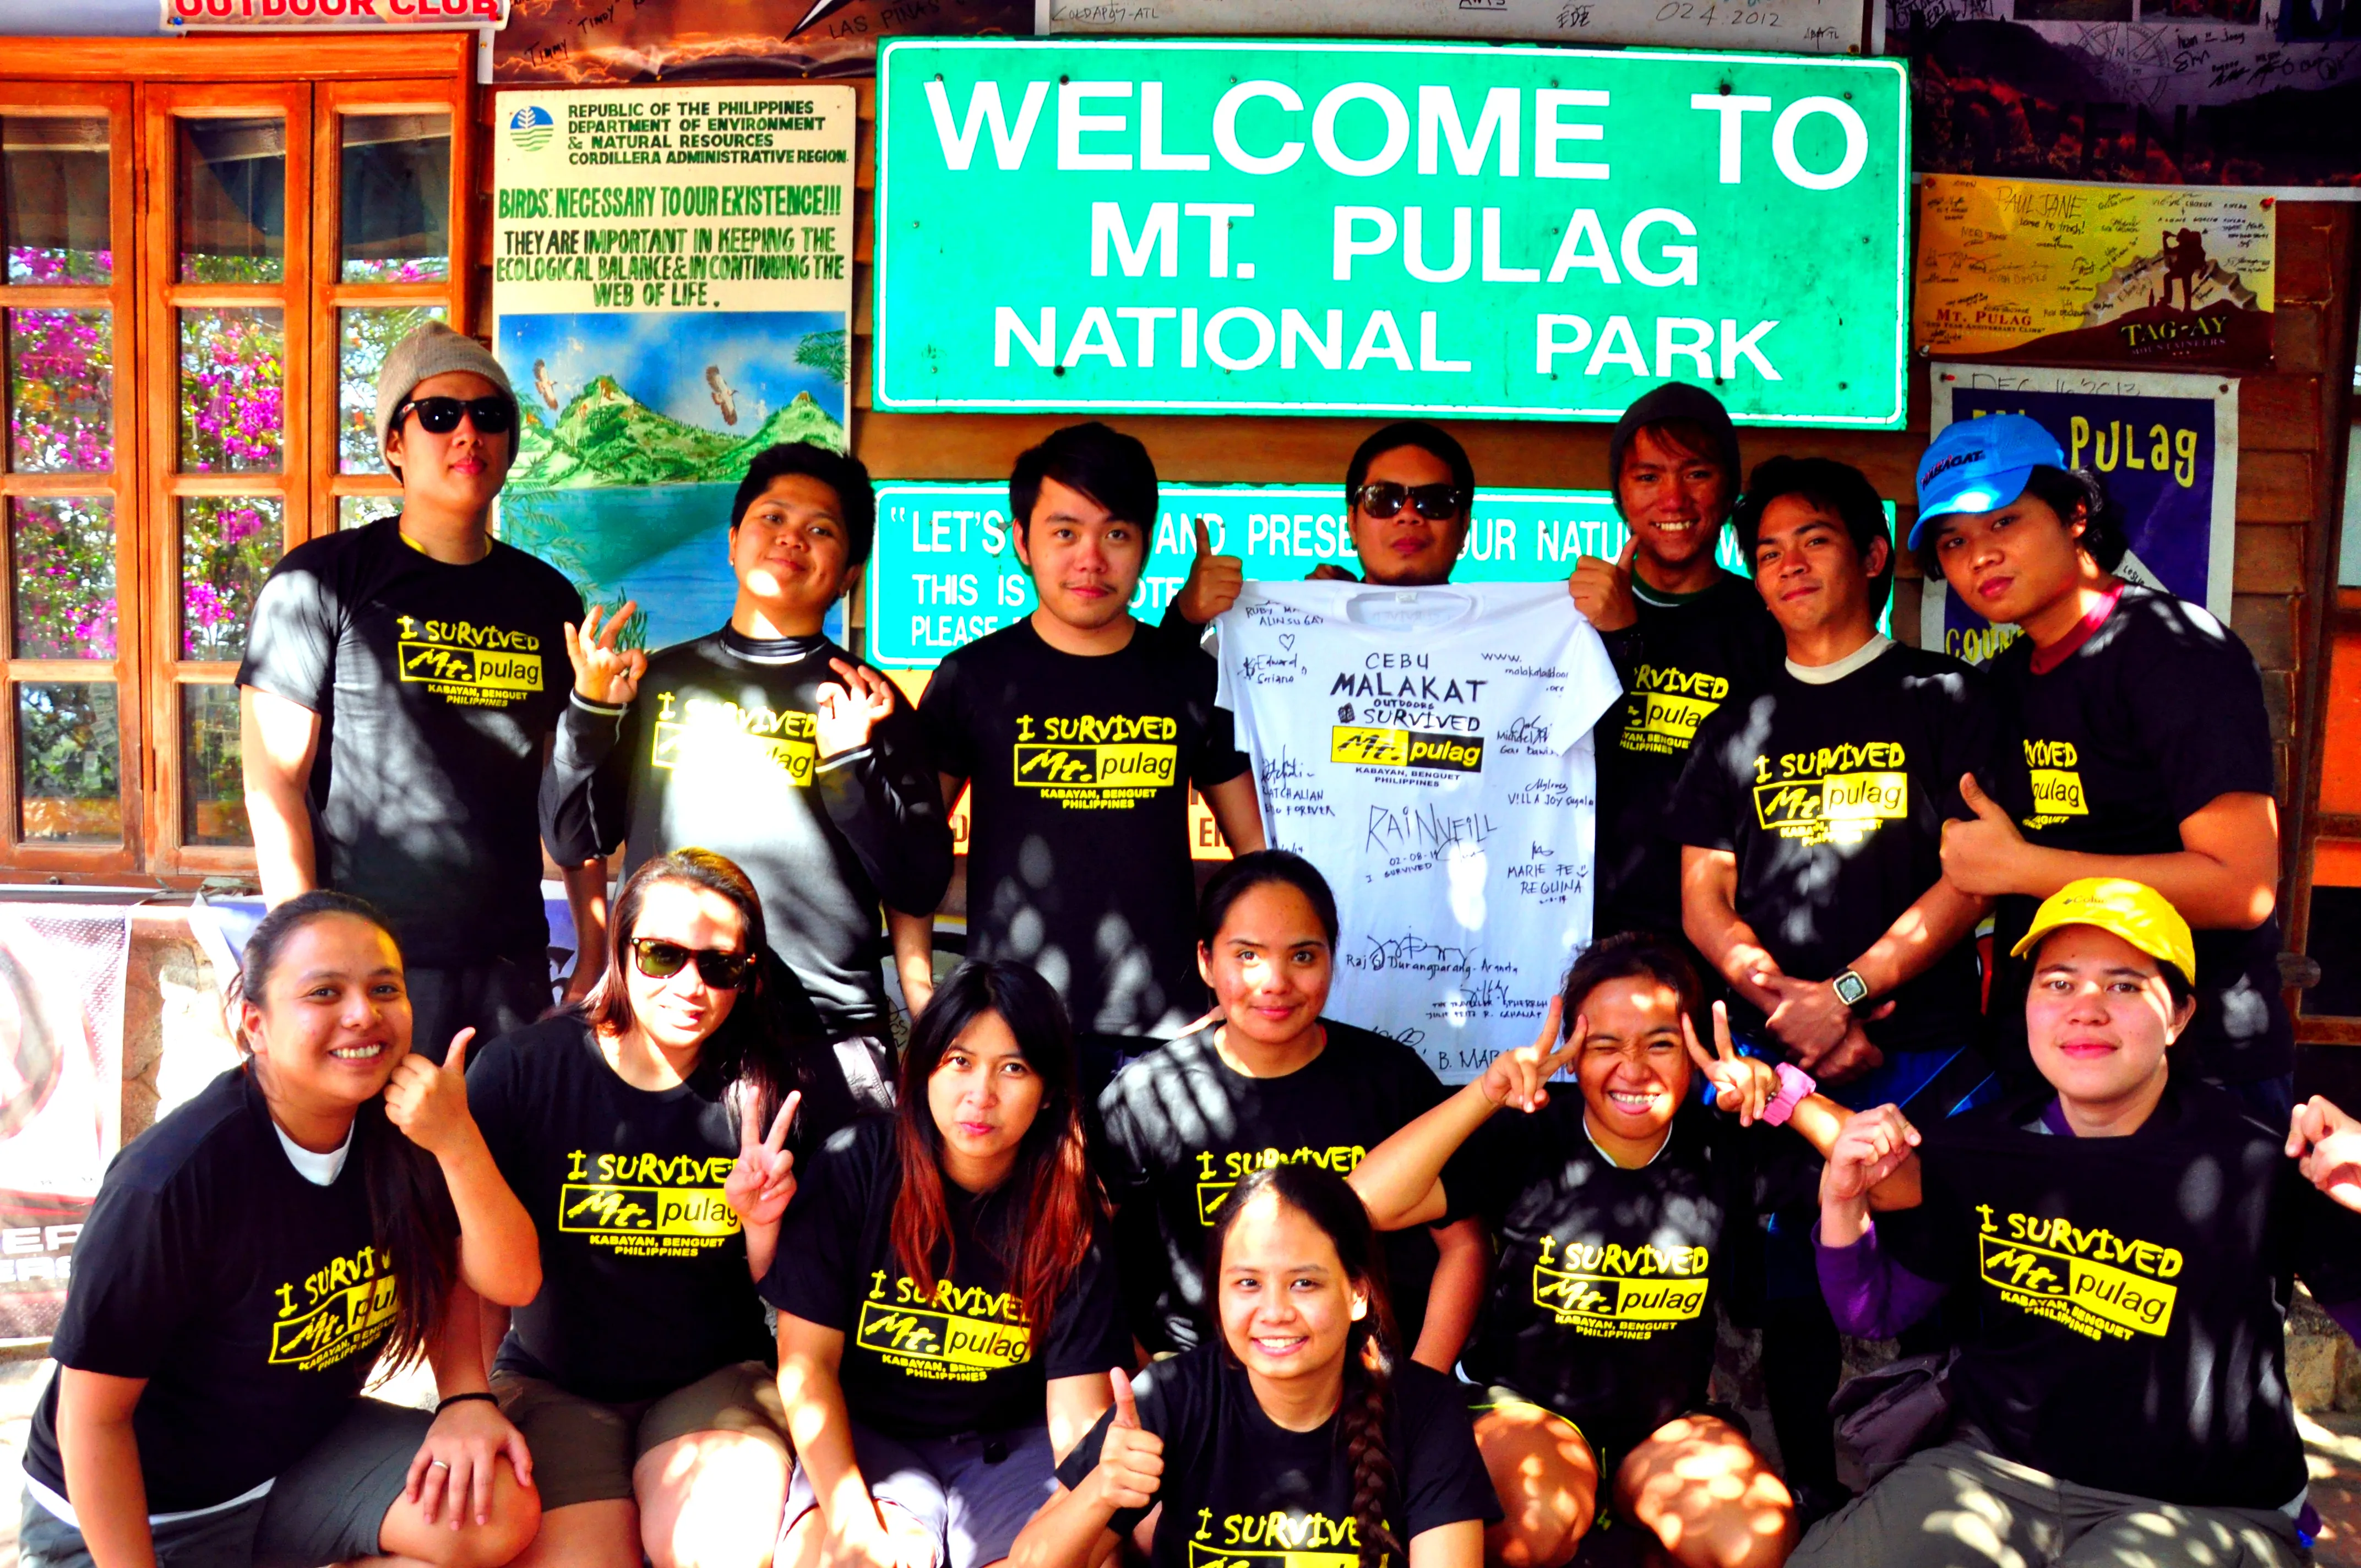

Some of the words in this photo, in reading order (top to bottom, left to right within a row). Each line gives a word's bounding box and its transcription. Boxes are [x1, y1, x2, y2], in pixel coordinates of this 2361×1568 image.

[829, 15, 868, 40] LAS
[568, 103, 644, 117] REPUBLIC
[651, 102, 671, 116] OF
[678, 102, 709, 116] THE
[719, 101, 813, 115] PHILIPPINES
[568, 119, 671, 134] DEPARTMENT
[679, 118, 700, 132] OF
[708, 117, 825, 131] ENVIRONMENT
[923, 80, 1611, 180] WELCOME
[1690, 94, 1869, 190] TO
[568, 137, 583, 149] &
[592, 134, 672, 149] NATURAL
[680, 134, 773, 148] RESOURCES
[569, 151, 661, 165] CORDILLERA
[666, 150, 795, 164] ADMINISTRATIVE
[556, 186, 656, 218] NECESSARY
[661, 186, 682, 216] TO
[683, 186, 718, 216] OUR
[722, 185, 841, 216] EXISTENCE!!!
[2039, 193, 2087, 220] JANE
[504, 230, 542, 255] THEY
[546, 230, 579, 254] ARE
[584, 228, 687, 254] IMPORTANT
[694, 228, 712, 253] IN
[719, 227, 795, 253] KEEPING
[801, 227, 836, 252] THE
[1091, 202, 1256, 279] MT.
[1333, 205, 1699, 287] PULAG
[497, 256, 593, 282] ECOLOGICAL
[709, 255, 810, 280] CONTINUING
[813, 254, 845, 279] THE
[593, 283, 634, 307] WEB
[643, 282, 665, 306] OF
[1976, 311, 2032, 326] PULAG
[2121, 316, 2228, 347] TAG-AY
[994, 307, 1472, 372] NATIONAL
[1536, 313, 1783, 381] PARK
[1538, 520, 1630, 565] NATU
[912, 574, 978, 606] THIS
[998, 575, 1025, 606] IS
[396, 616, 417, 639] I
[425, 620, 539, 651] SURVIVED
[407, 649, 472, 680] Mt.
[480, 660, 539, 684] pulag
[1366, 653, 1428, 669] CEBU
[428, 684, 480, 698] KABAYAN,
[482, 689, 527, 700] BENGUET
[1330, 672, 1488, 704] MALAKAT
[1634, 664, 1729, 699] RVIVED
[447, 695, 508, 707] PHILIPPINES
[657, 692, 676, 720] I
[1016, 715, 1035, 741] I
[1045, 715, 1177, 743] SURVIVED
[1363, 709, 1480, 731] SURVIVED
[1410, 741, 1481, 766] pulag
[1647, 733, 1691, 749] BENGUE
[1020, 749, 1092, 781] Mt.
[1100, 752, 1173, 780] pulag
[1356, 767, 1407, 777] KABAYAN,
[1411, 770, 1460, 780] BENGUET
[1753, 755, 1772, 783] I
[1041, 789, 1100, 799] KABAYAN,
[1102, 789, 1157, 798] BENGUET
[1375, 777, 1439, 787] PHILIPPINES
[1830, 780, 1902, 810] pulag
[1063, 799, 1135, 809] PHILIPPINES
[1508, 864, 1546, 879] MARIE
[568, 1150, 587, 1180] I
[598, 1153, 738, 1185] SURVIVE
[1196, 1151, 1217, 1180] I
[567, 1190, 652, 1228] Mt.
[590, 1235, 659, 1247] KABAYAN,
[663, 1238, 725, 1247] BENGUET
[615, 1246, 698, 1257] PHILIPPINES
[1976, 1204, 1998, 1232] I
[2008, 1213, 2183, 1278] SURVIVED
[1539, 1235, 1555, 1265] I
[1565, 1243, 1709, 1276] SURVIVED
[869, 1270, 886, 1299] I
[1539, 1278, 1612, 1313] Mt.
[1620, 1287, 1703, 1314] pulag
[1985, 1248, 2064, 1293] Mt.
[2075, 1273, 2167, 1325] pulag
[275, 1282, 297, 1317] I
[1555, 1314, 1615, 1330] KABAYAN,
[1619, 1321, 1677, 1330] BENGUET
[2001, 1290, 2070, 1315] KABAYAN,
[2071, 1304, 2134, 1341] BENGUET
[2025, 1306, 2102, 1341] PHILIPPINES
[280, 1311, 344, 1353] Mt.
[864, 1312, 940, 1353] Mt.
[948, 1331, 1026, 1363] pulag
[1576, 1326, 1651, 1340] PHILIPPINES
[298, 1339, 350, 1370] KABAYAN,
[882, 1354, 946, 1372] KABAYAN,
[906, 1368, 987, 1381] PHILIPPINES
[1195, 1507, 1212, 1540] I
